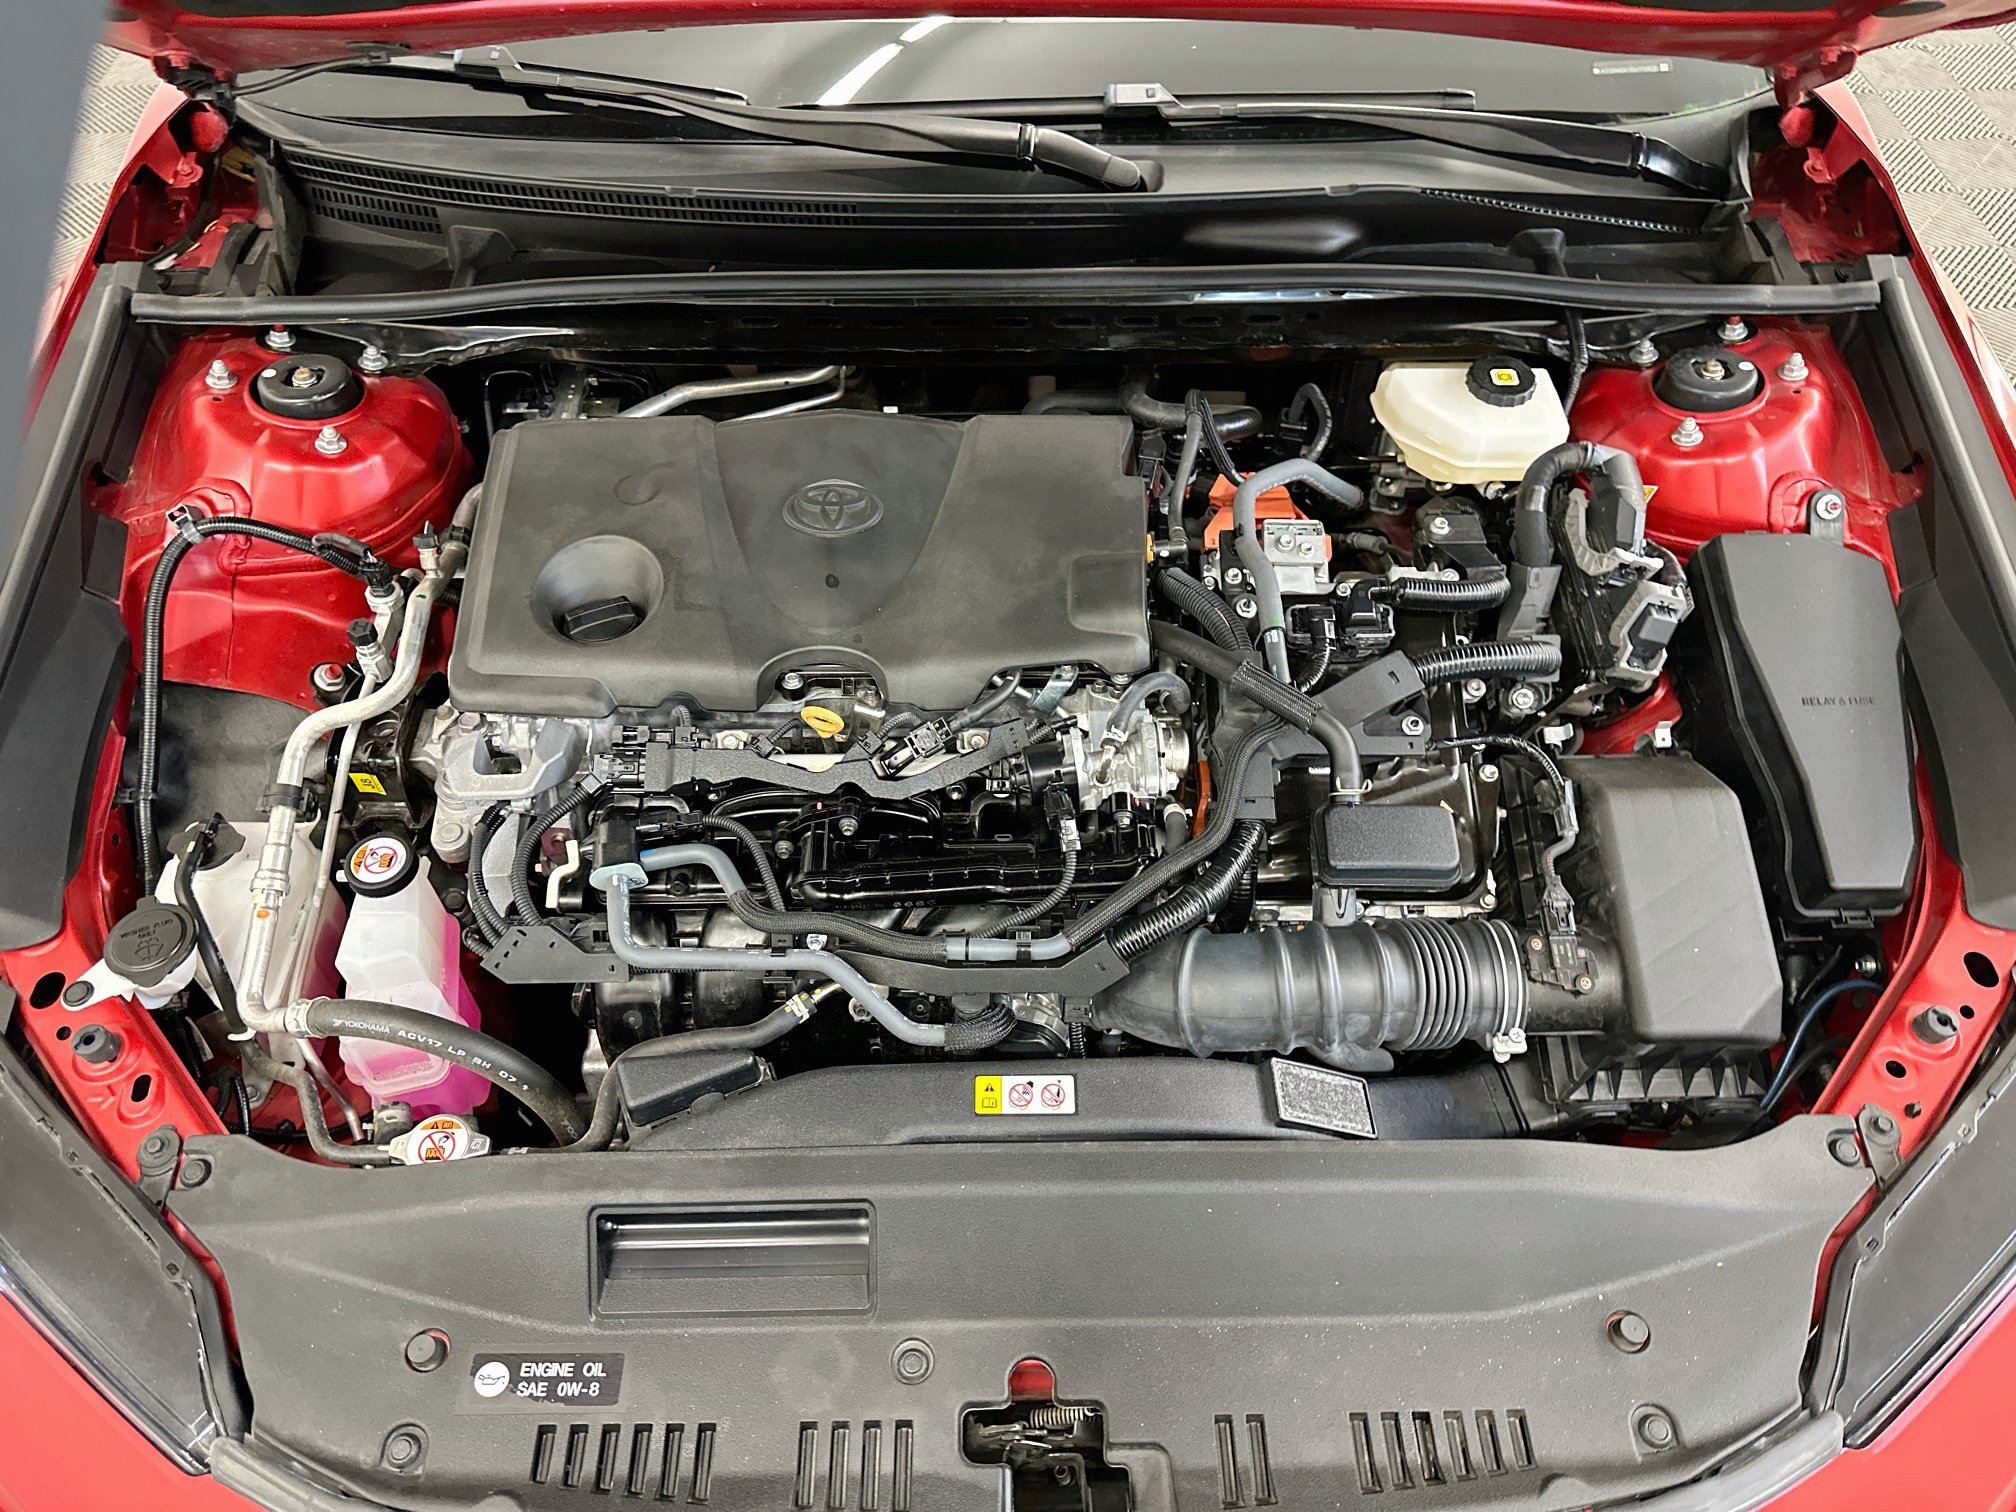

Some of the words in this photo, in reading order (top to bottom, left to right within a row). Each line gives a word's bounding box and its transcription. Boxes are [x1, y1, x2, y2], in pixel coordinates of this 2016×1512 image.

[1801, 696, 1836, 706] RELAY
[344, 1020, 391, 1035] YOKOHAMA
[397, 1029, 443, 1048] ACV17
[447, 1045, 467, 1057] LP
[519, 1362, 576, 1378] ENGINE
[582, 1362, 608, 1378] OIL
[516, 1380, 549, 1398] SAE
[556, 1381, 600, 1397] 0W-8
